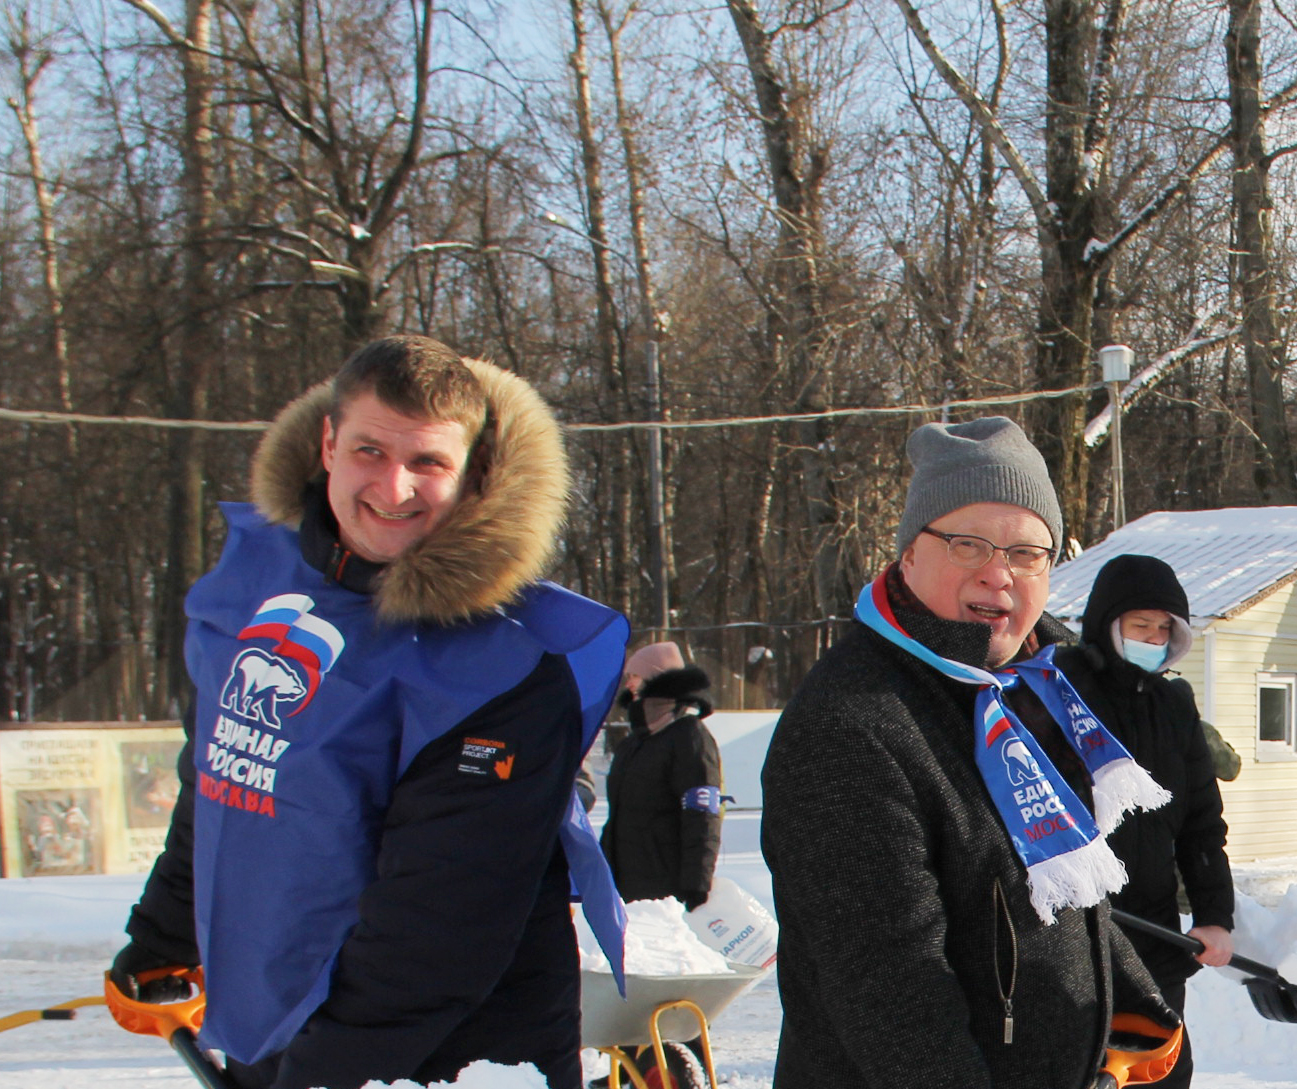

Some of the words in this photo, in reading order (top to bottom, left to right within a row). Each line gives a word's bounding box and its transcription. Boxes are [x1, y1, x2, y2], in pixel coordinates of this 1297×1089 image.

[213, 714, 291, 763] ЕДИНАЯ
[206, 742, 277, 793] РОССИЯ
[199, 771, 276, 819] МОСКВА
[1013, 779, 1055, 806] ЕДИ
